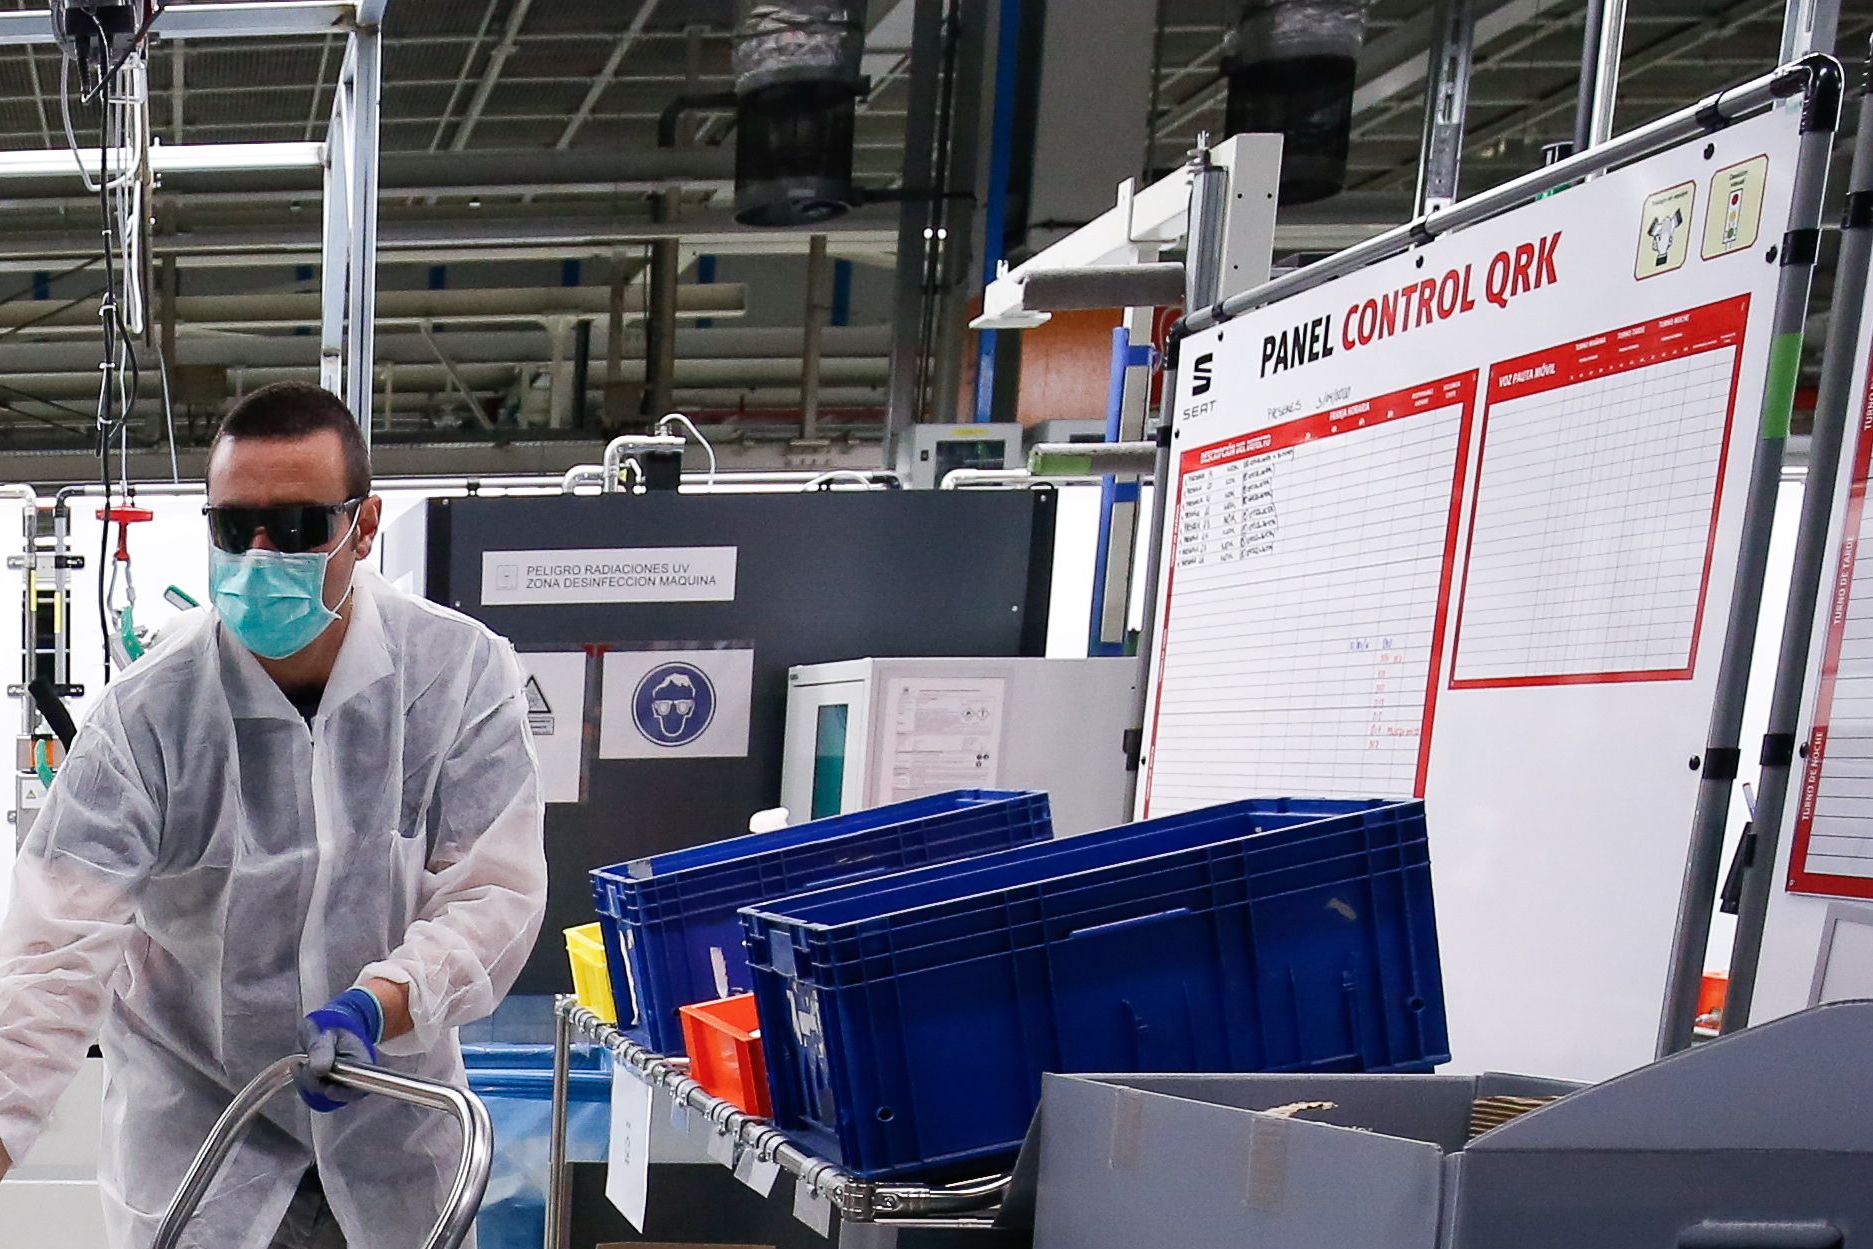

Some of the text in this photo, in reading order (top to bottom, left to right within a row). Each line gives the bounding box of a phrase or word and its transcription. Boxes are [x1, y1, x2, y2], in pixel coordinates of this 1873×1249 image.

[1259, 231, 1564, 379] PANEL CONTROL QRK
[1183, 400, 1217, 421] SEAT
[526, 563, 691, 576] PELIGRO RADIACIONES UV
[526, 575, 717, 589] ZONA DESINFECCION MAQUINA
